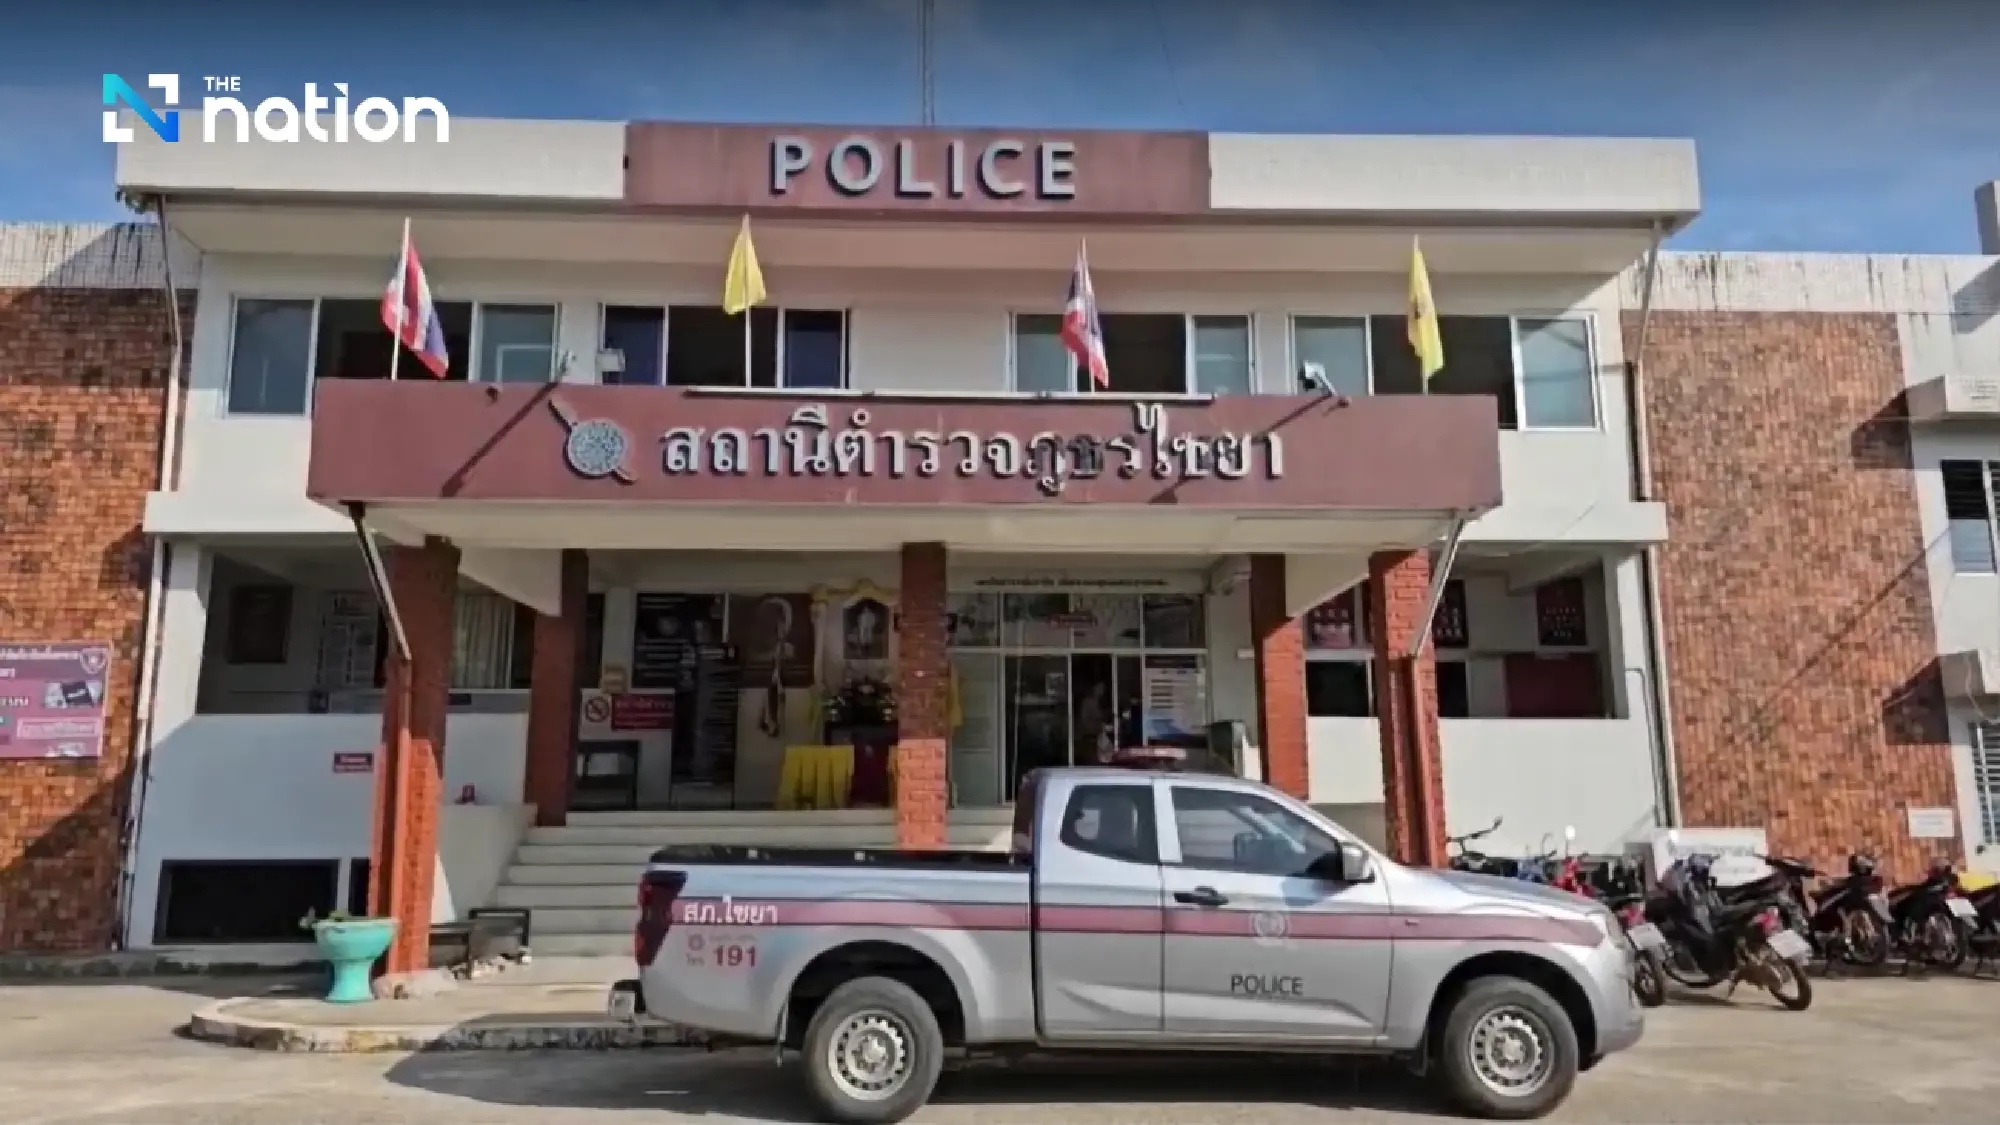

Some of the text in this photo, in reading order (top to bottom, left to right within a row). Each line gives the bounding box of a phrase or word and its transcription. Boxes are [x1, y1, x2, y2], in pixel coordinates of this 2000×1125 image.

[770, 136, 1076, 200] POLICE
[660, 401, 1284, 496] สถานีตำรวจภูธรไชยา
[713, 944, 757, 968] 191
[1230, 973, 1304, 996] POLICE
